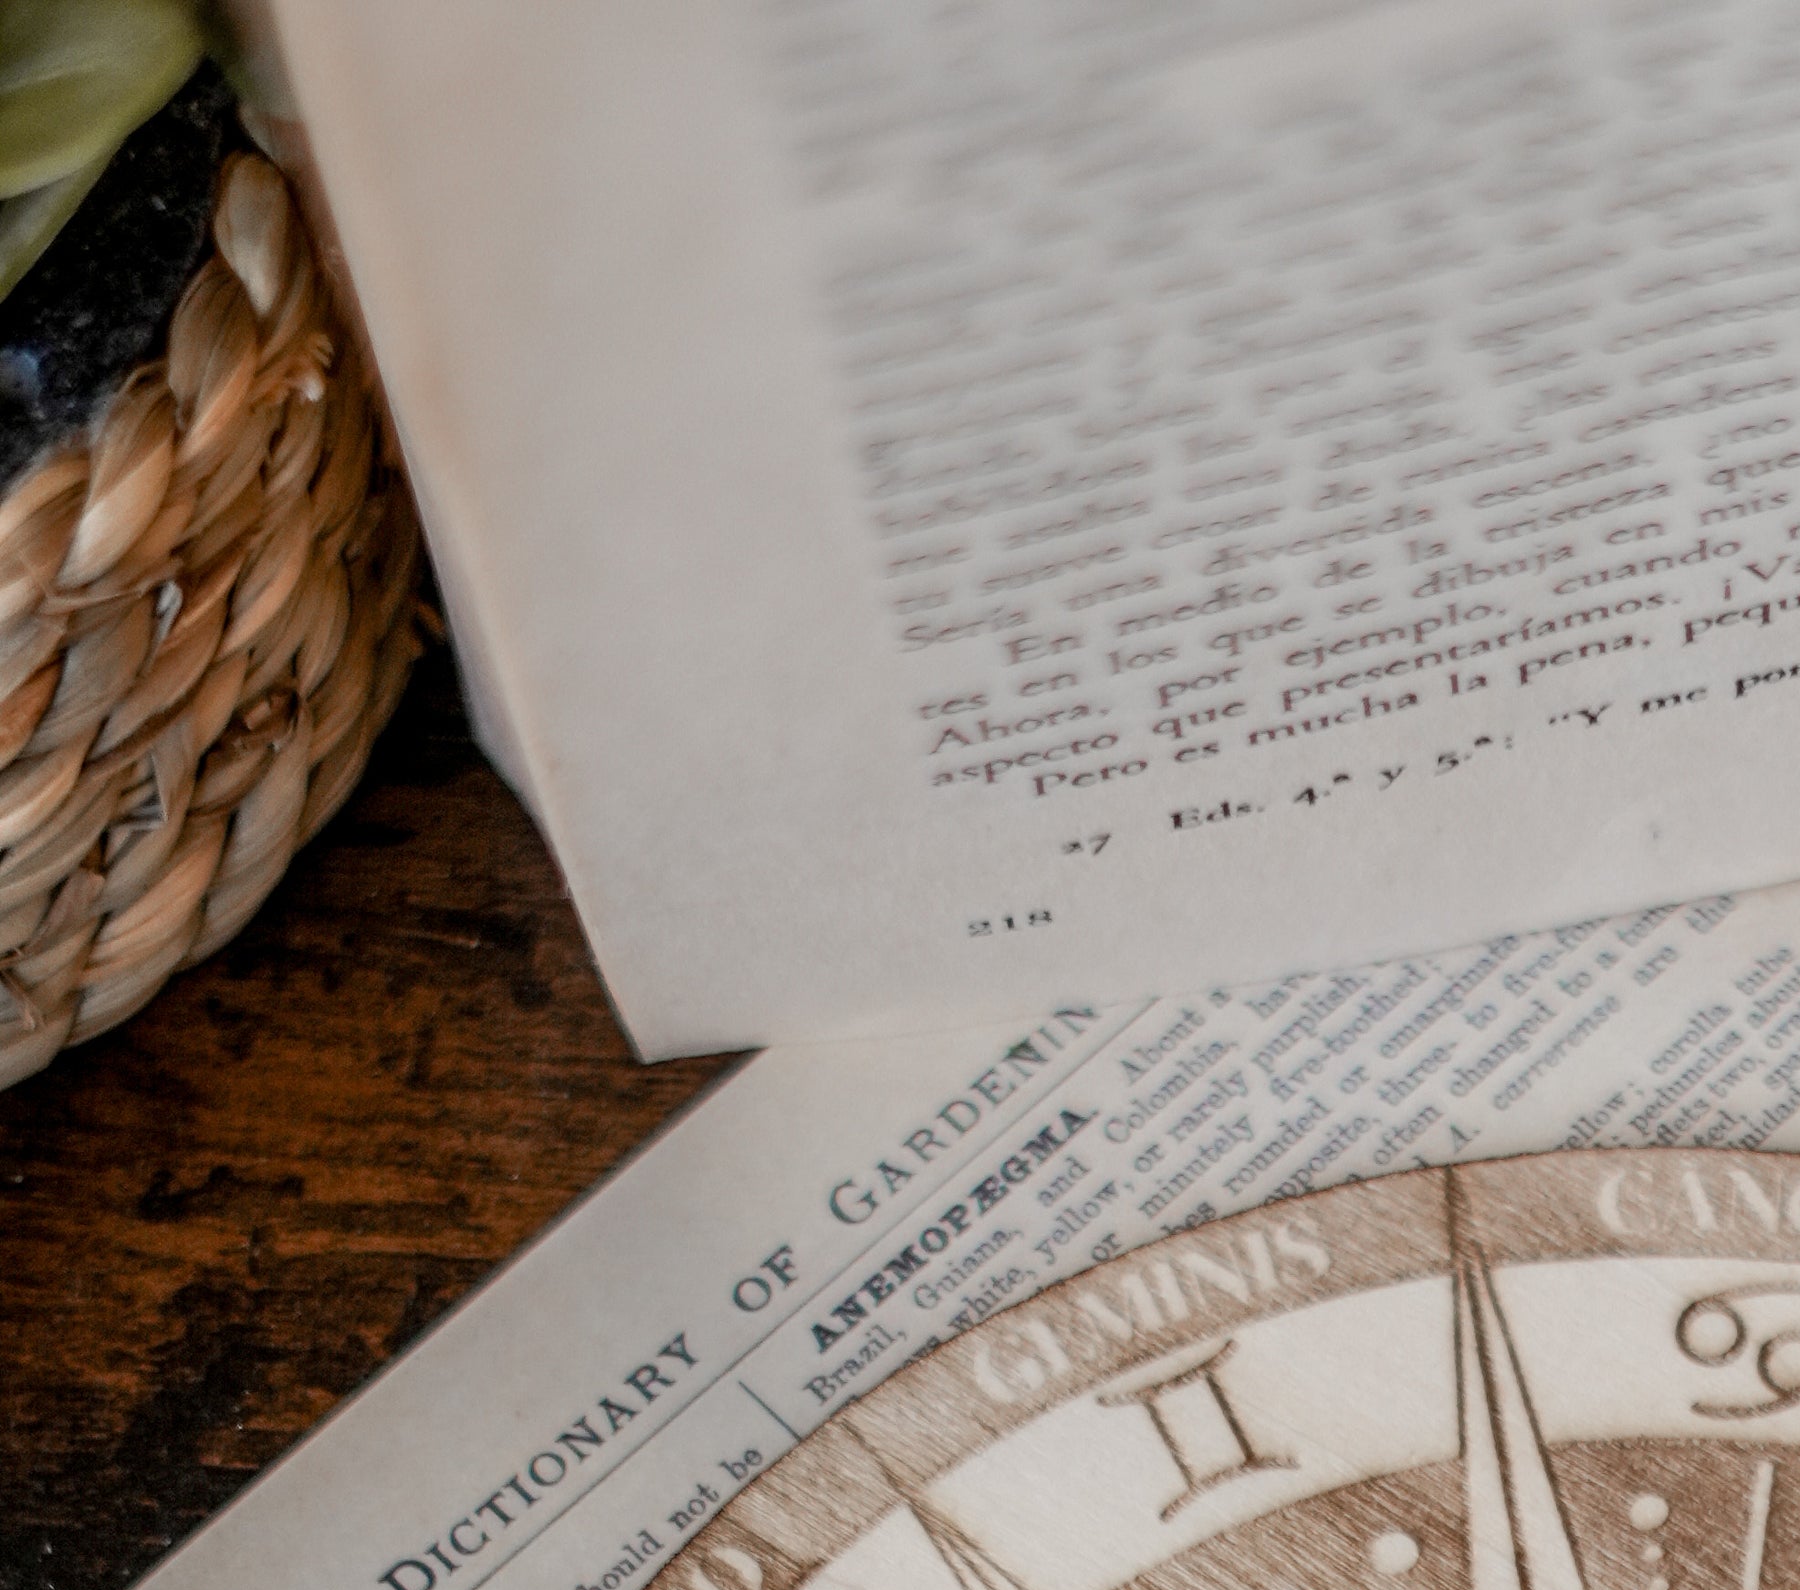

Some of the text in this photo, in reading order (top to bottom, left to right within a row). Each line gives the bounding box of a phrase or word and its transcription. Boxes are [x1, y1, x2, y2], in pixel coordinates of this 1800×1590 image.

[1157, 666, 1242, 708] por
[1553, 539, 1742, 596] cuando
[932, 731, 1120, 786] aspecto
[1152, 700, 1249, 739] que
[1033, 757, 1149, 798] Pero
[1173, 740, 1220, 764] es
[1246, 690, 1418, 747] mucha
[1449, 672, 1489, 696] la
[1170, 800, 1267, 831] Eds.
[1378, 763, 1406, 792] y
[1640, 687, 1708, 715] me
[1463, 1003, 1500, 1032] to
[1133, 1070, 1251, 1175] or rarely
[1139, 1114, 1255, 1220] minutely
[1222, 1066, 1370, 1197] rounded or
[1036, 1154, 1092, 1208] and
[731, 1244, 800, 1314] OF
[972, 1219, 1332, 1403] GEMINIS
[666, 1482, 721, 1534] not
[718, 1447, 764, 1482] be
